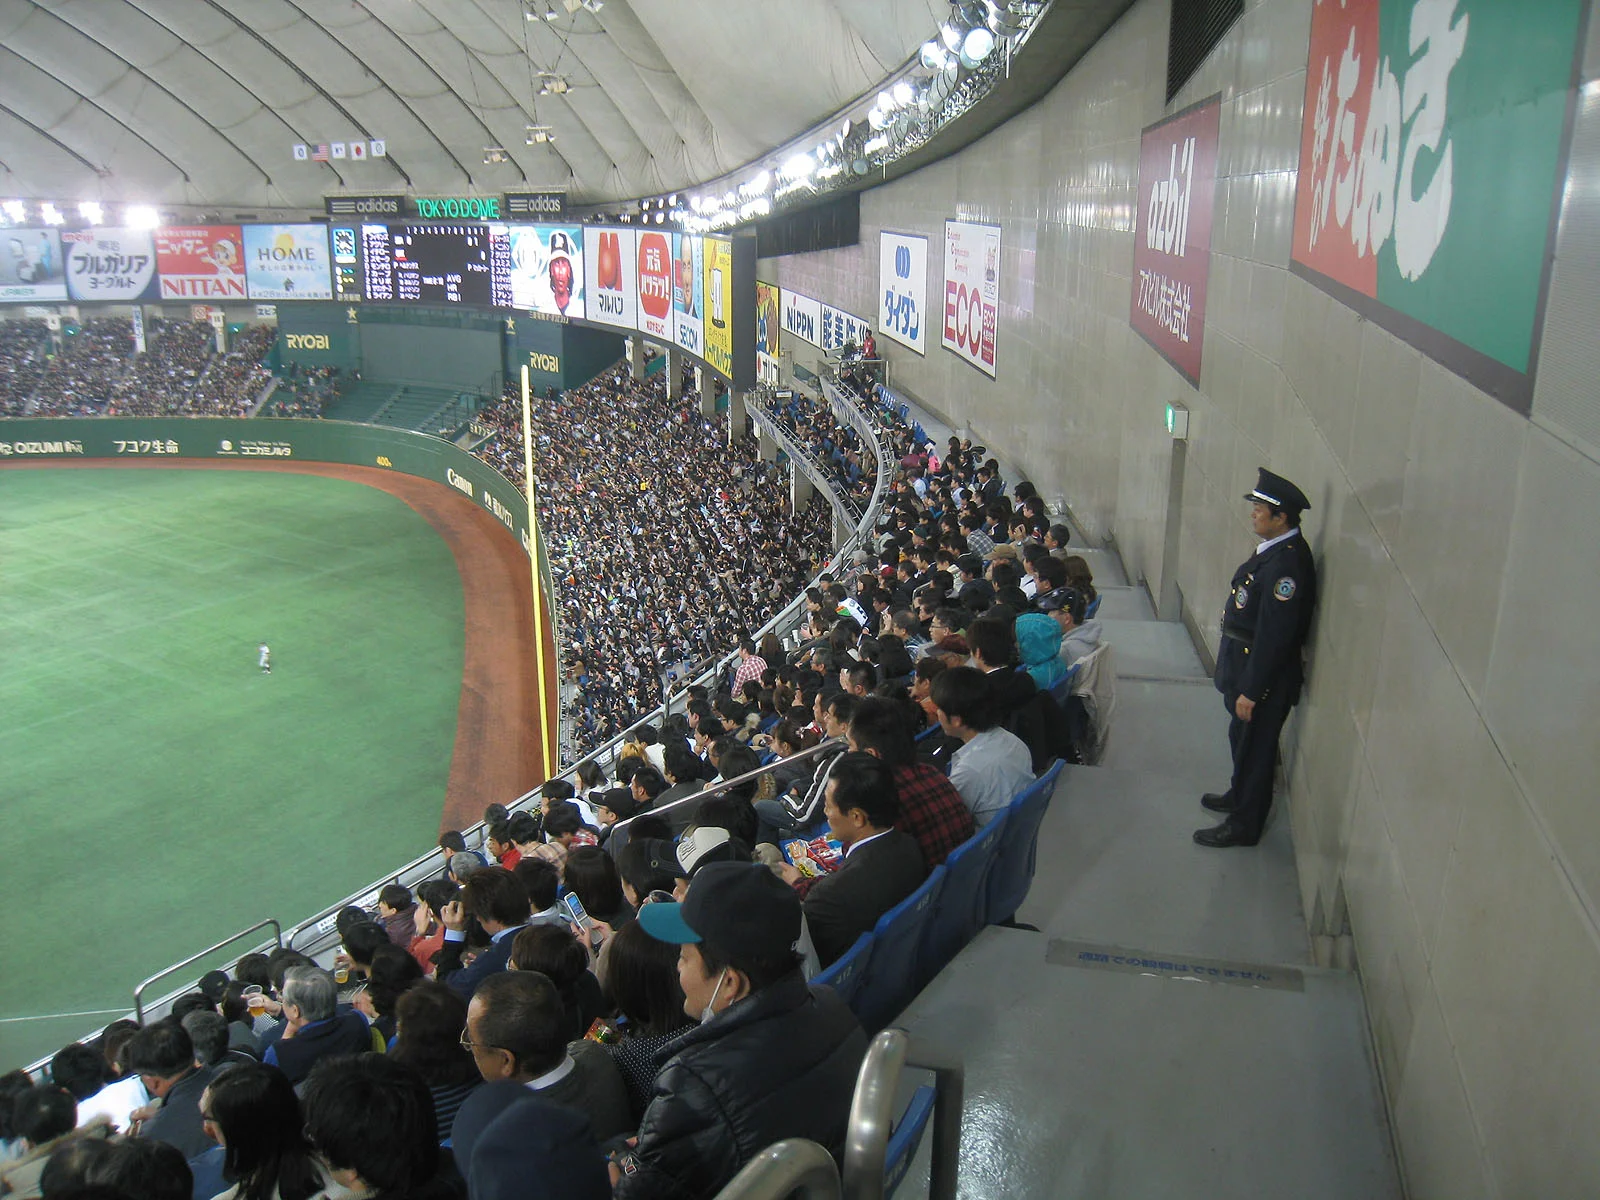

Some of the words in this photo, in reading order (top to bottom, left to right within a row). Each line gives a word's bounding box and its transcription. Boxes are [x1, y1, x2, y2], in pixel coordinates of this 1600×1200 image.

[357, 198, 397, 213] adidas
[528, 195, 561, 213] adidas
[1147, 137, 1196, 258] azbil
[415, 199, 459, 218] TOKYO
[460, 199, 500, 218] DOME
[73, 252, 149, 275] ブルガリア
[258, 247, 317, 262] HOME
[646, 247, 662, 273] 元気
[89, 276, 137, 289] ヨーグルト
[163, 279, 245, 297] NITTAN
[598, 294, 624, 315] マルハン
[884, 286, 920, 341] ダイダン
[1137, 268, 1191, 343] アズビル株式会社
[944, 279, 982, 357] ECC
[286, 333, 329, 350] RYOBI
[529, 352, 559, 373] RYOBI
[14, 441, 64, 454] OIZUMI
[112, 439, 179, 454] フコク生命
[447, 468, 473, 497] Canon
